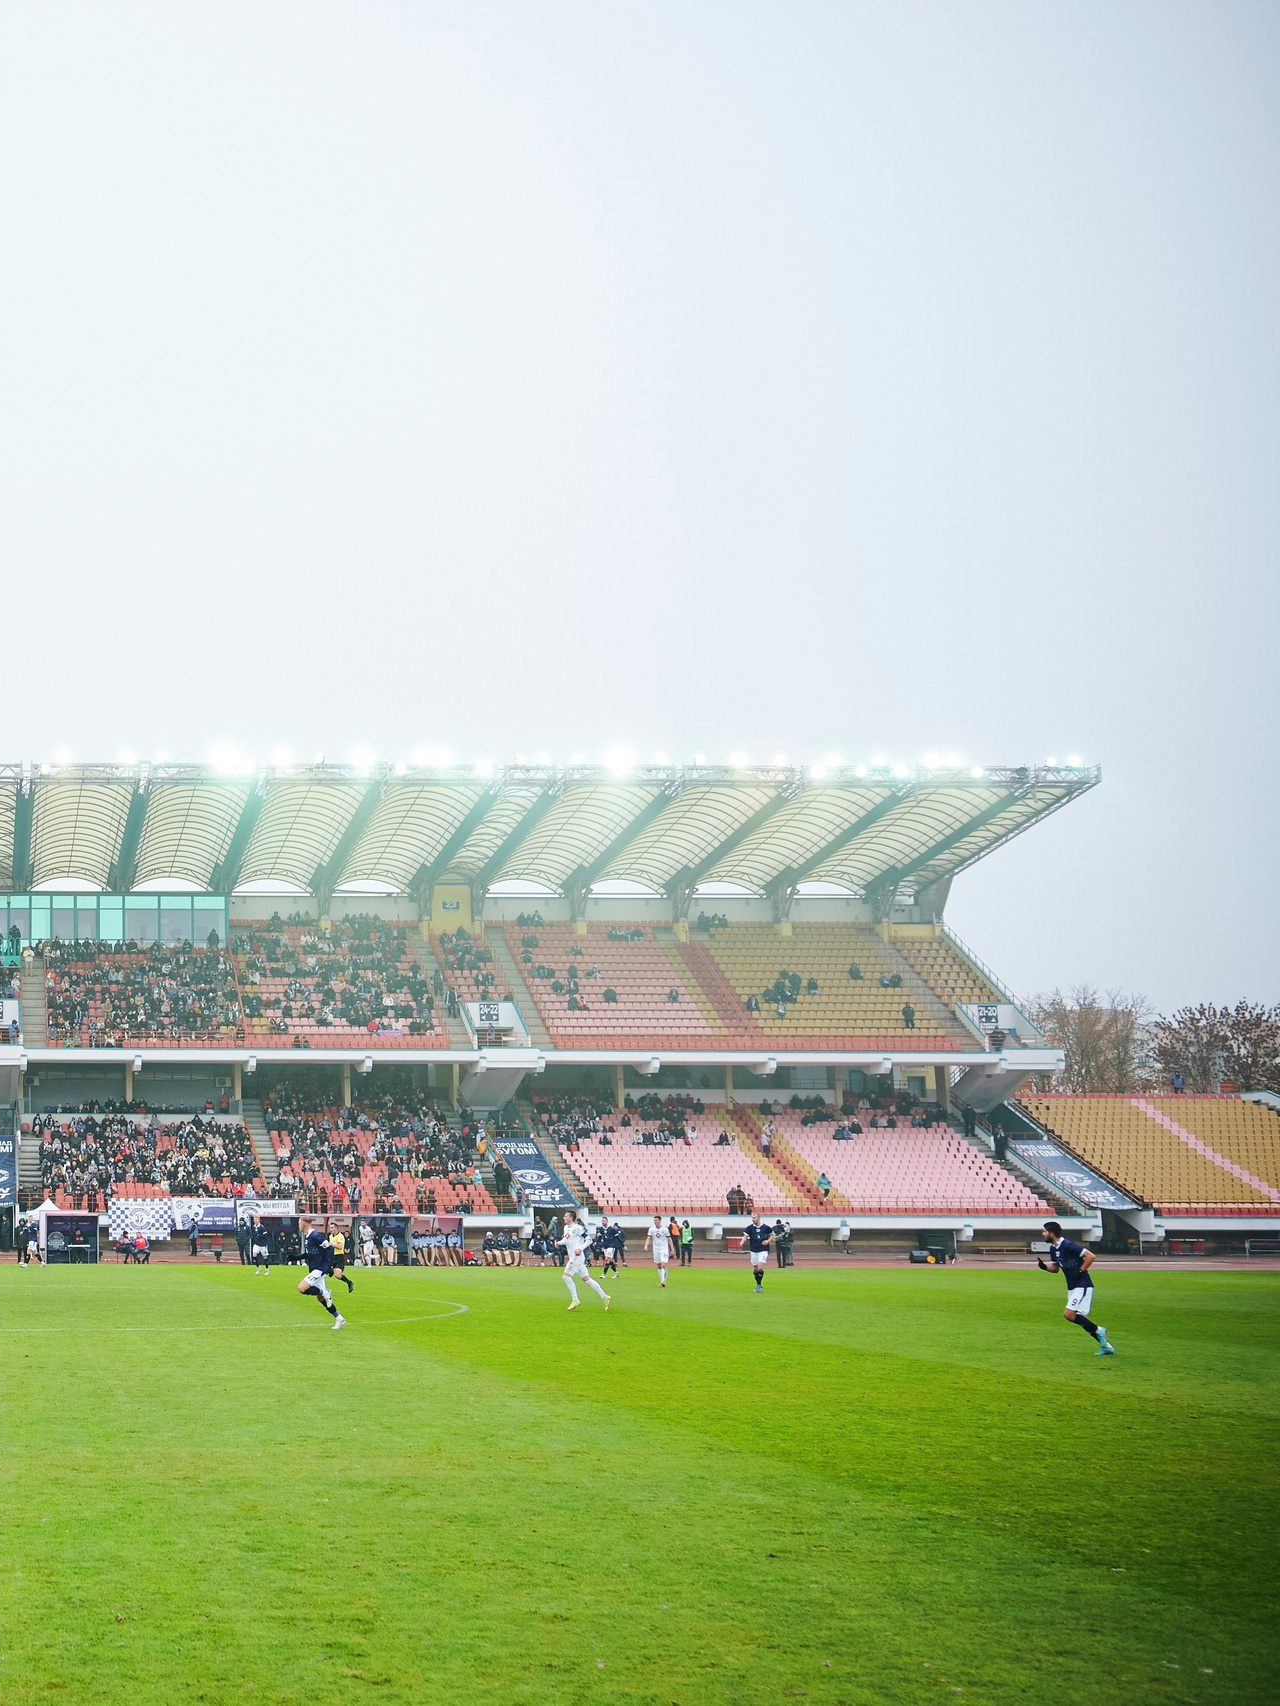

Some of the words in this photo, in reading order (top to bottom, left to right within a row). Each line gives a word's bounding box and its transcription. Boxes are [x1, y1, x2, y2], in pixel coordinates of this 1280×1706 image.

[480, 1004, 498, 1014] 24-22
[978, 1006, 997, 1016] 21-20
[1071, 1298, 1078, 1306] 9
